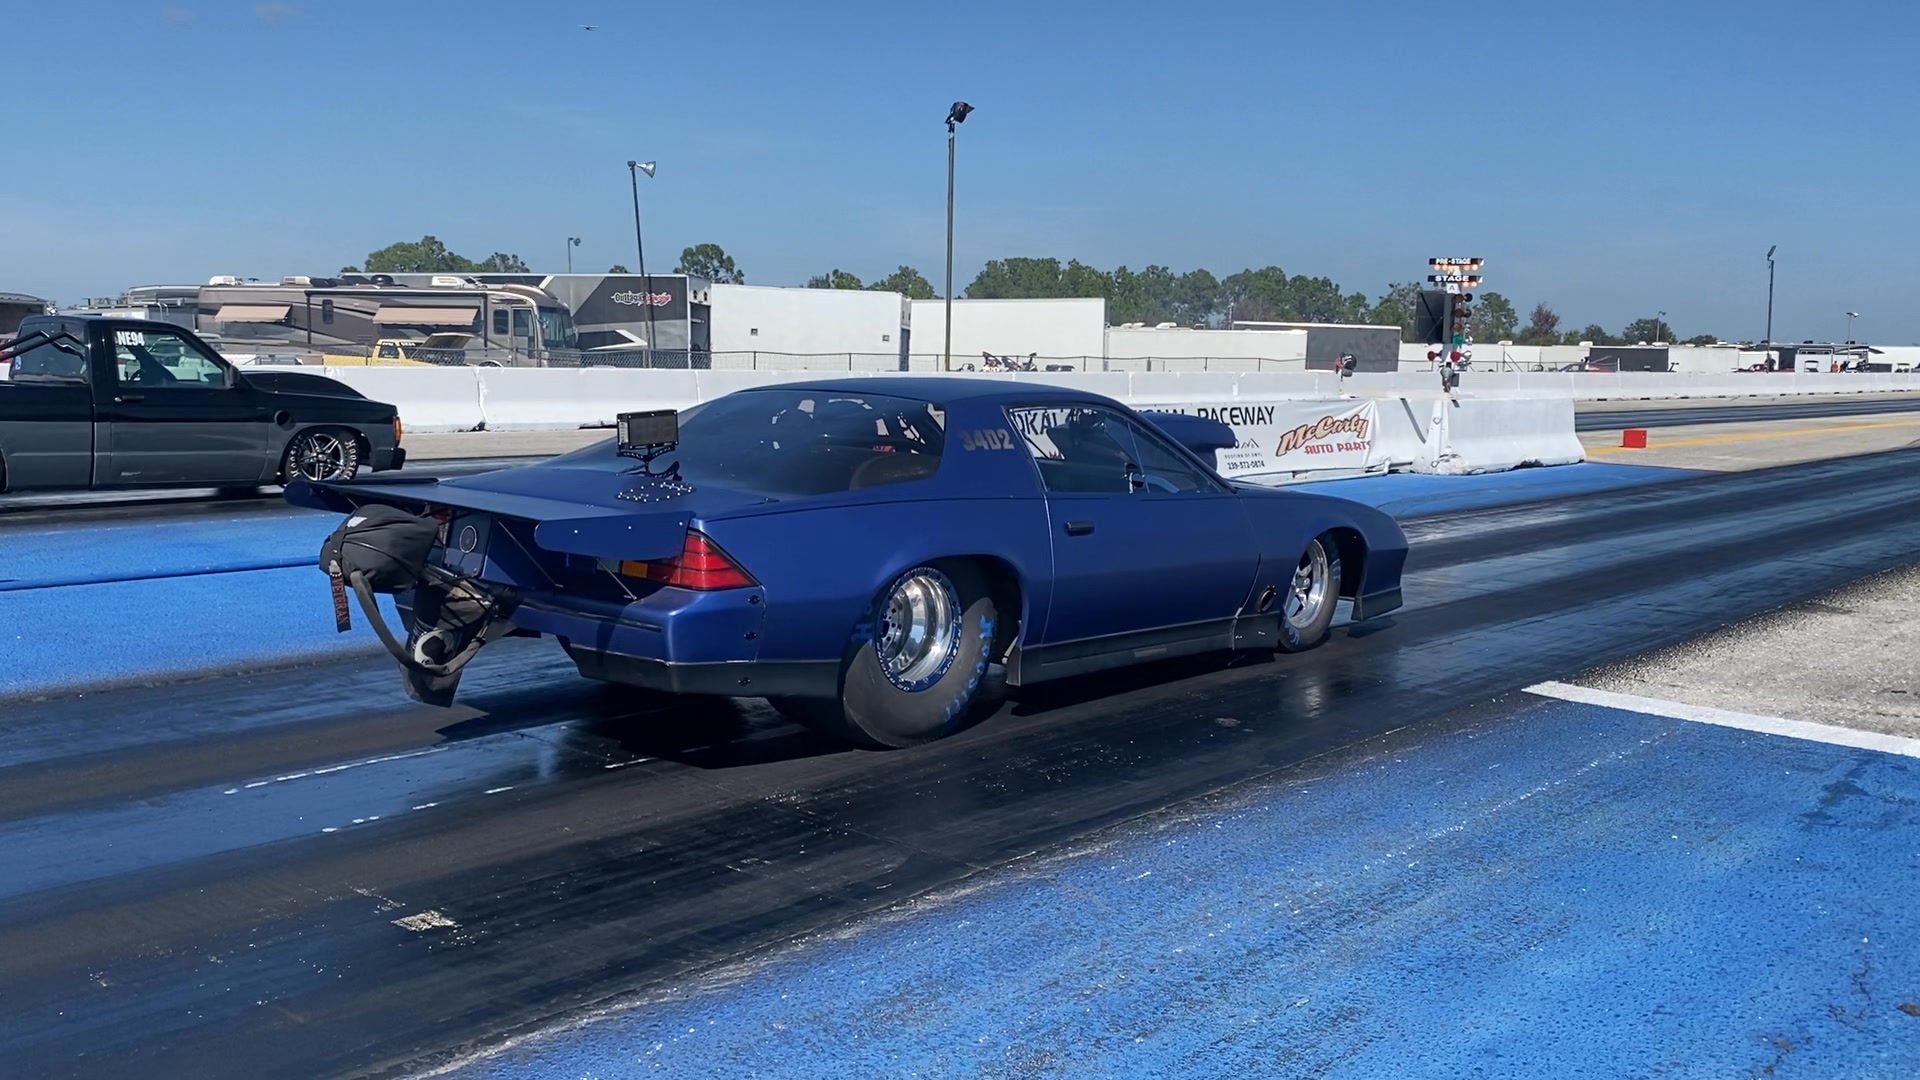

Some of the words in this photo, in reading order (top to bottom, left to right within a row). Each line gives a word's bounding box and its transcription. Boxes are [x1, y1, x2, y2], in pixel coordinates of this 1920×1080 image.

[116, 331, 145, 346] NE94
[1276, 414, 1369, 457] McCarty
[1304, 442, 1334, 454] AUTO
[1337, 440, 1372, 452] PARTS
